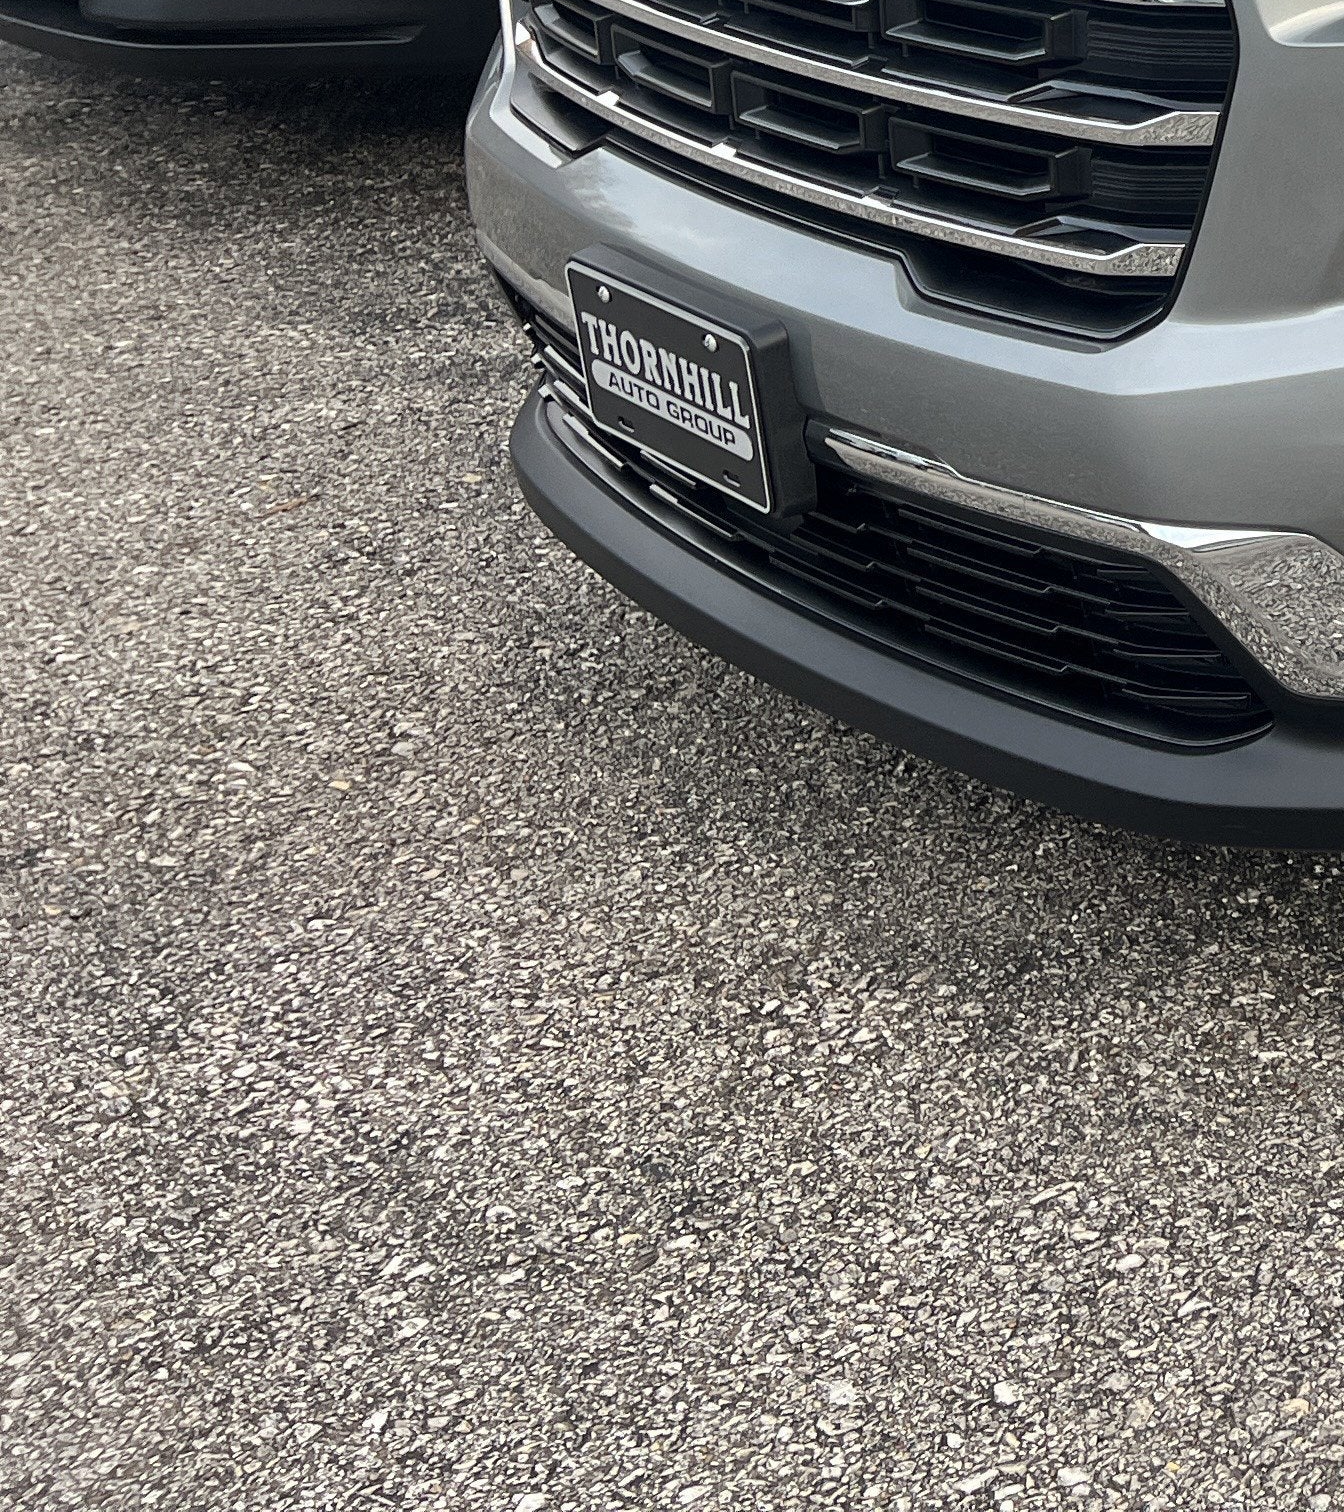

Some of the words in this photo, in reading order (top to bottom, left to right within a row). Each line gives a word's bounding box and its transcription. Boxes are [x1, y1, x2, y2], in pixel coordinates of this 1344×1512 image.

[581, 311, 750, 429] THORNHILL
[608, 371, 661, 411] AUTO
[666, 399, 736, 446] GROUP
